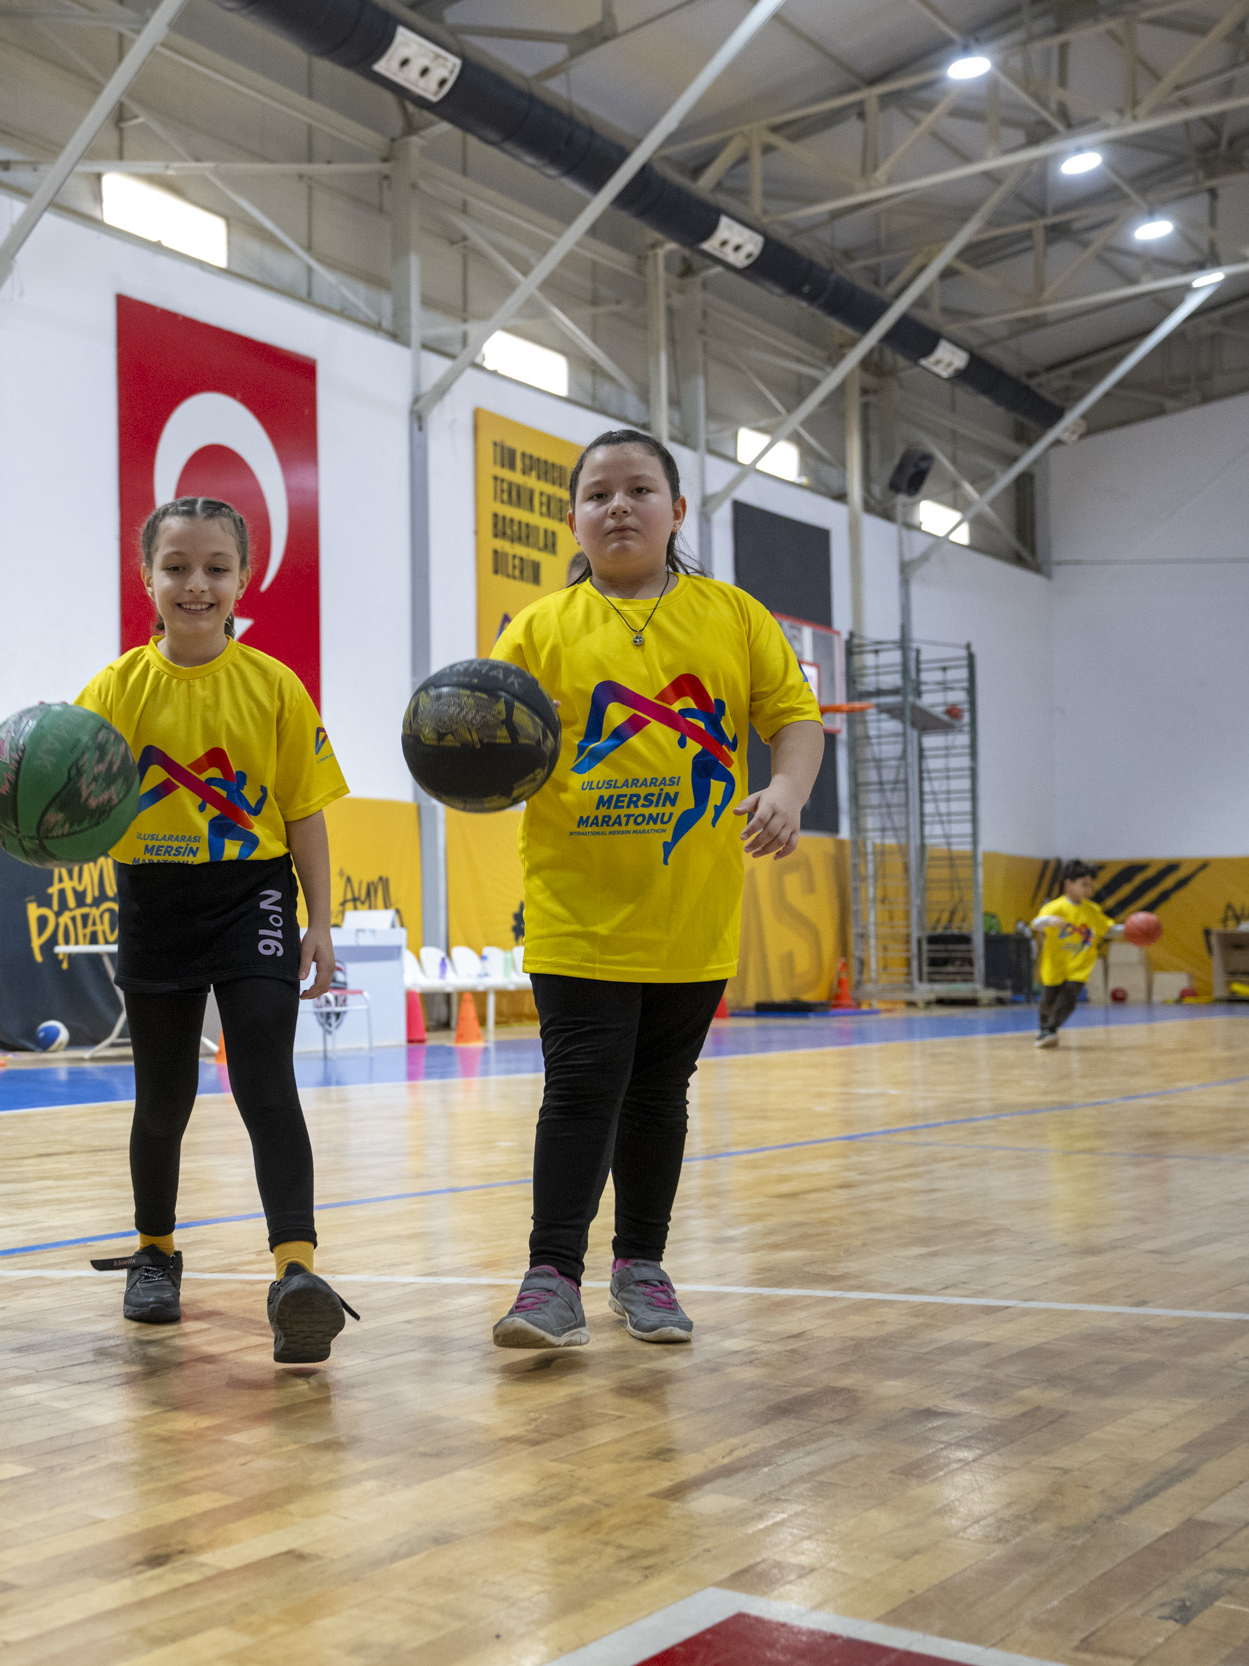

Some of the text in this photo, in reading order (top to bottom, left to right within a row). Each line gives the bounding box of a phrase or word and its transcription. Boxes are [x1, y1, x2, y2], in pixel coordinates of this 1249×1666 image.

[580, 775, 681, 791] ULUSLARARASI
[595, 788, 680, 810] MERSİN
[576, 812, 674, 828] MARATONU
[136, 832, 201, 844] ULUSLARARASI
[143, 843, 200, 858] MERSİN
[26, 901, 119, 970] POTAD
